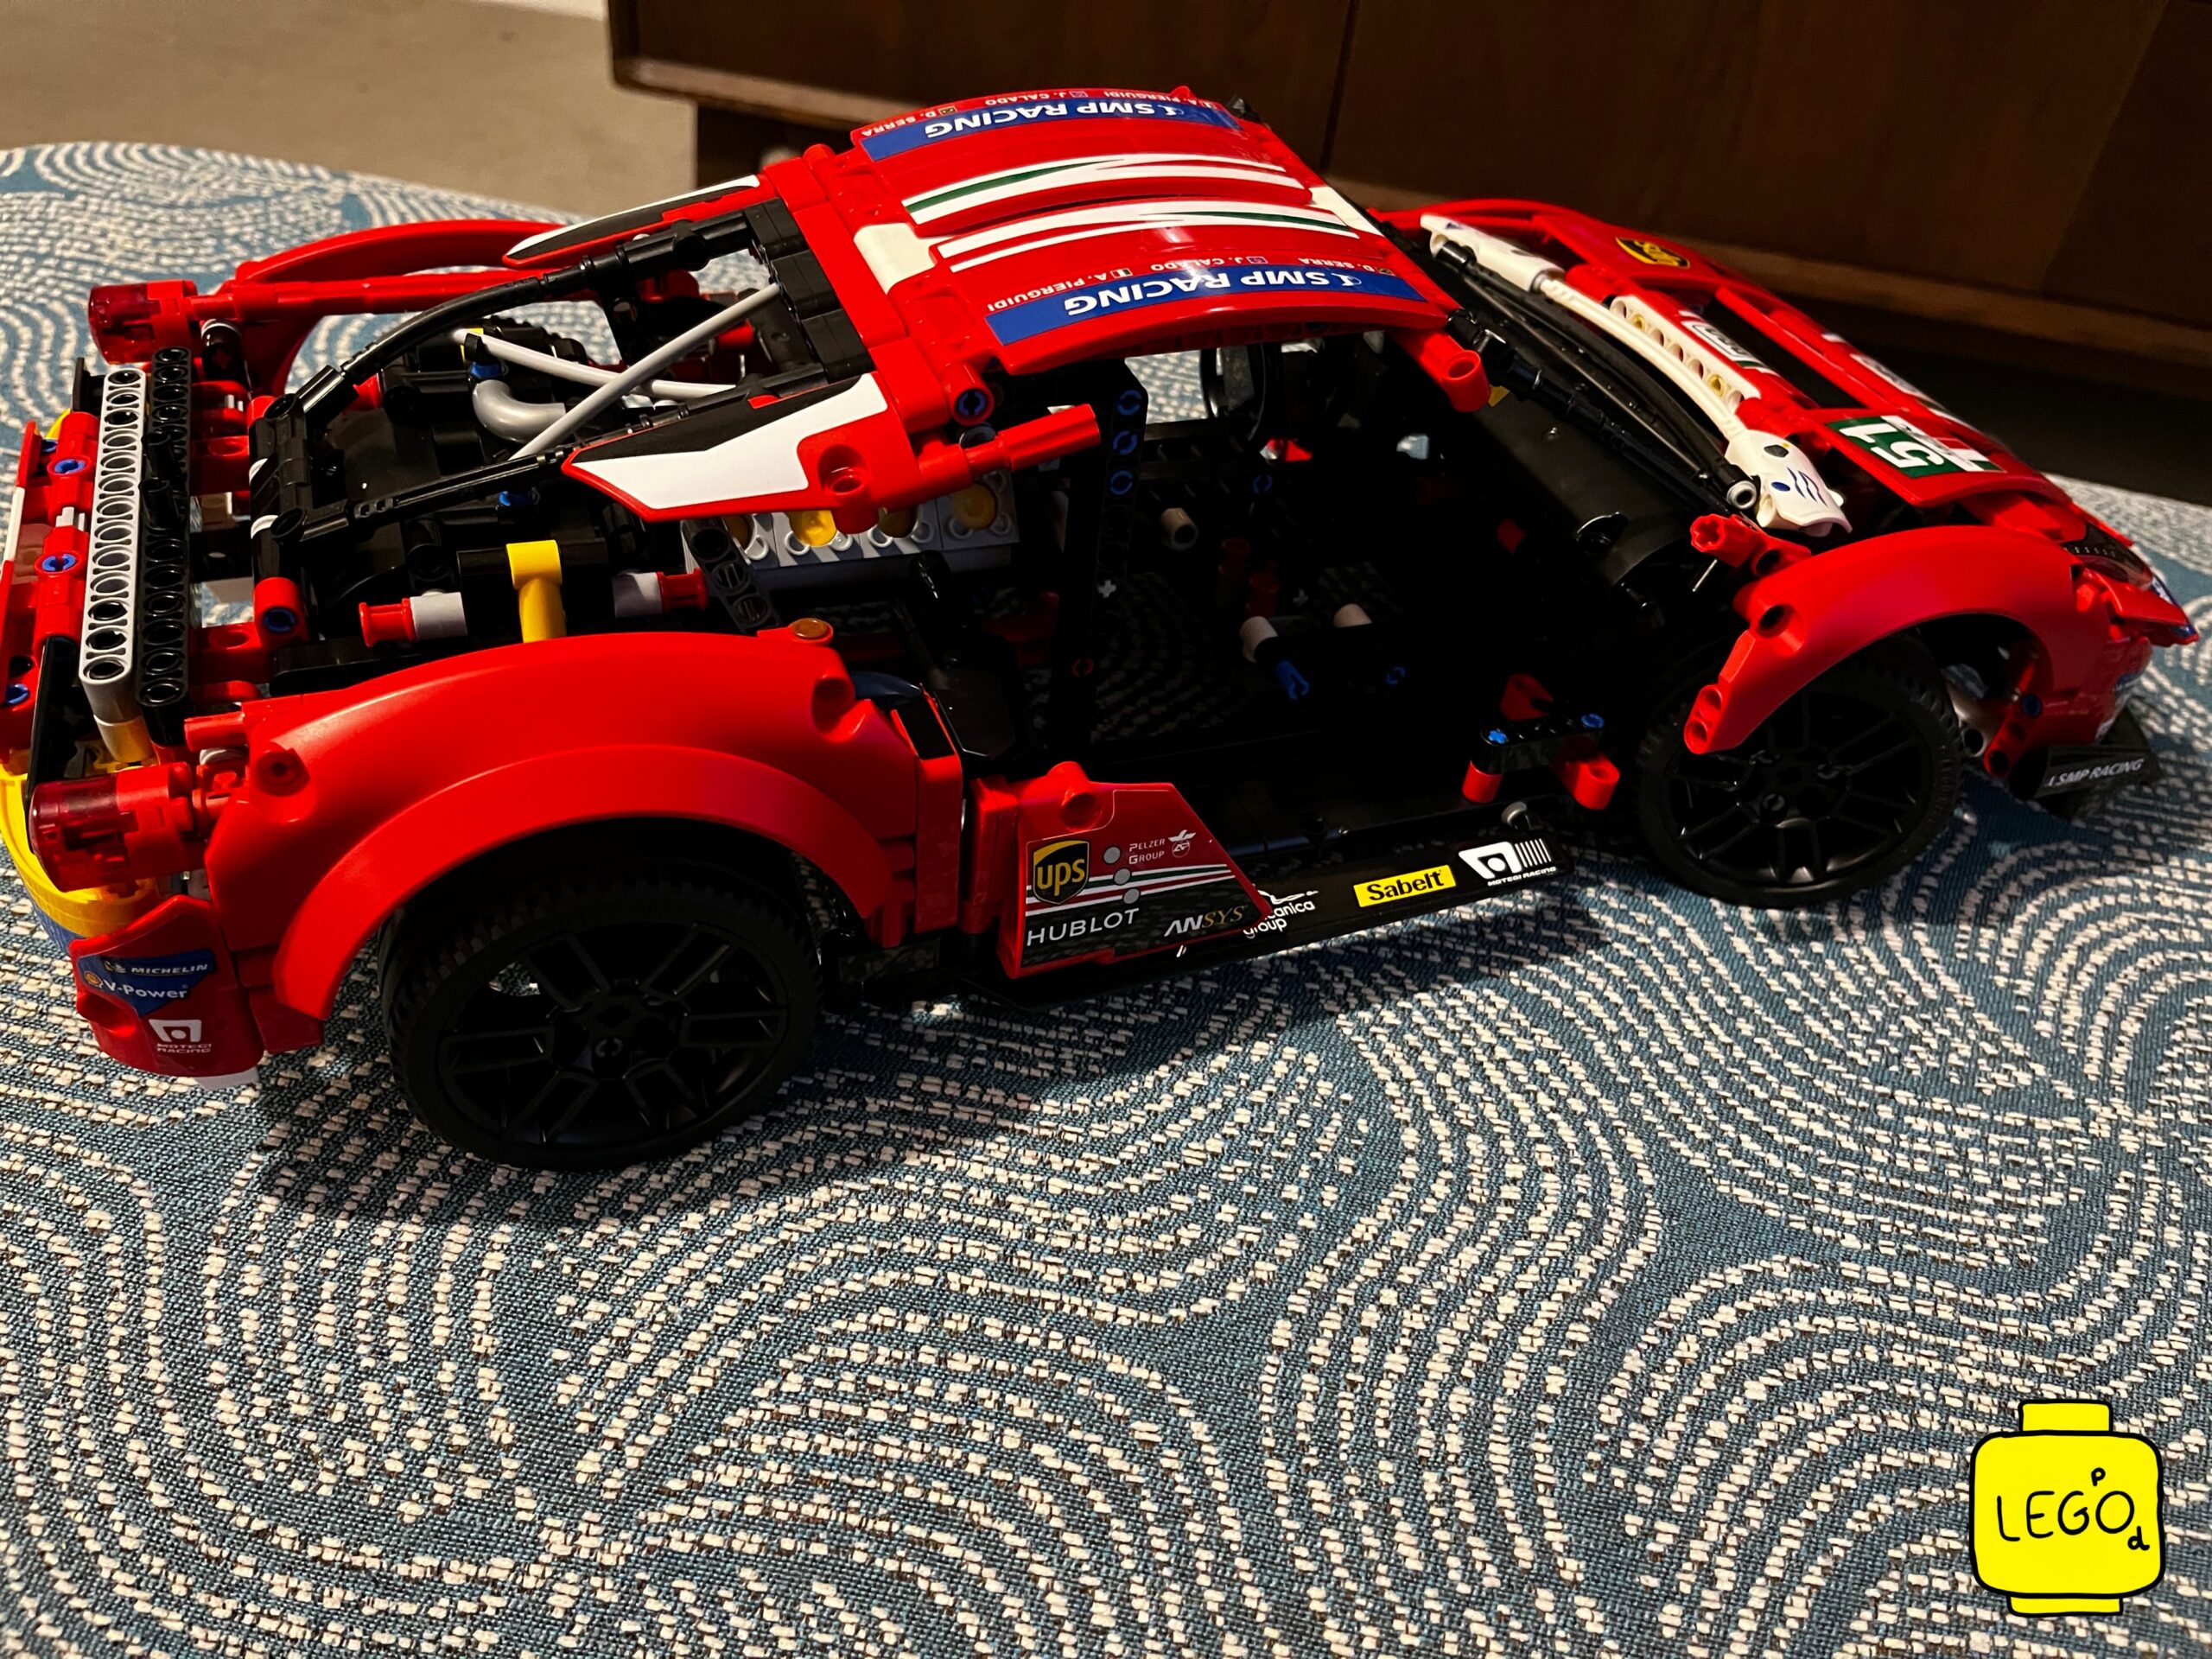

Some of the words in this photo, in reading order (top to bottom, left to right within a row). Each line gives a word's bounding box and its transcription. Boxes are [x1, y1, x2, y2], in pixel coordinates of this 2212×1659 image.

[984, 92, 1050, 105] CALADO
[1076, 102, 1155, 114] SMP
[861, 116, 917, 137] SERRA
[925, 103, 1068, 138] RACING
[1150, 257, 1223, 272] CALADO
[1298, 257, 1350, 269] SERRA
[1357, 263, 1375, 272] D.
[1088, 272, 1108, 281] A.
[1240, 270, 1330, 286] SMP
[987, 278, 1086, 312] PIERGUIDI
[1064, 272, 1231, 316] RACING
[1839, 423, 1945, 469] 51
[2055, 768, 2090, 785] SMP
[2089, 758, 2145, 779] RACING
[1128, 838, 1166, 853] PELZER
[1128, 850, 1165, 865] GROUP
[1037, 858, 1085, 897] ups
[1366, 871, 1444, 901] Sabelt
[1487, 874, 1522, 887] MOTEGI
[1522, 866, 1557, 879] RACING
[1027, 907, 1140, 947] HUBLOT
[1164, 906, 1245, 938] ANSYS
[130, 963, 208, 975] MICHELIN
[103, 978, 188, 999] V-Power
